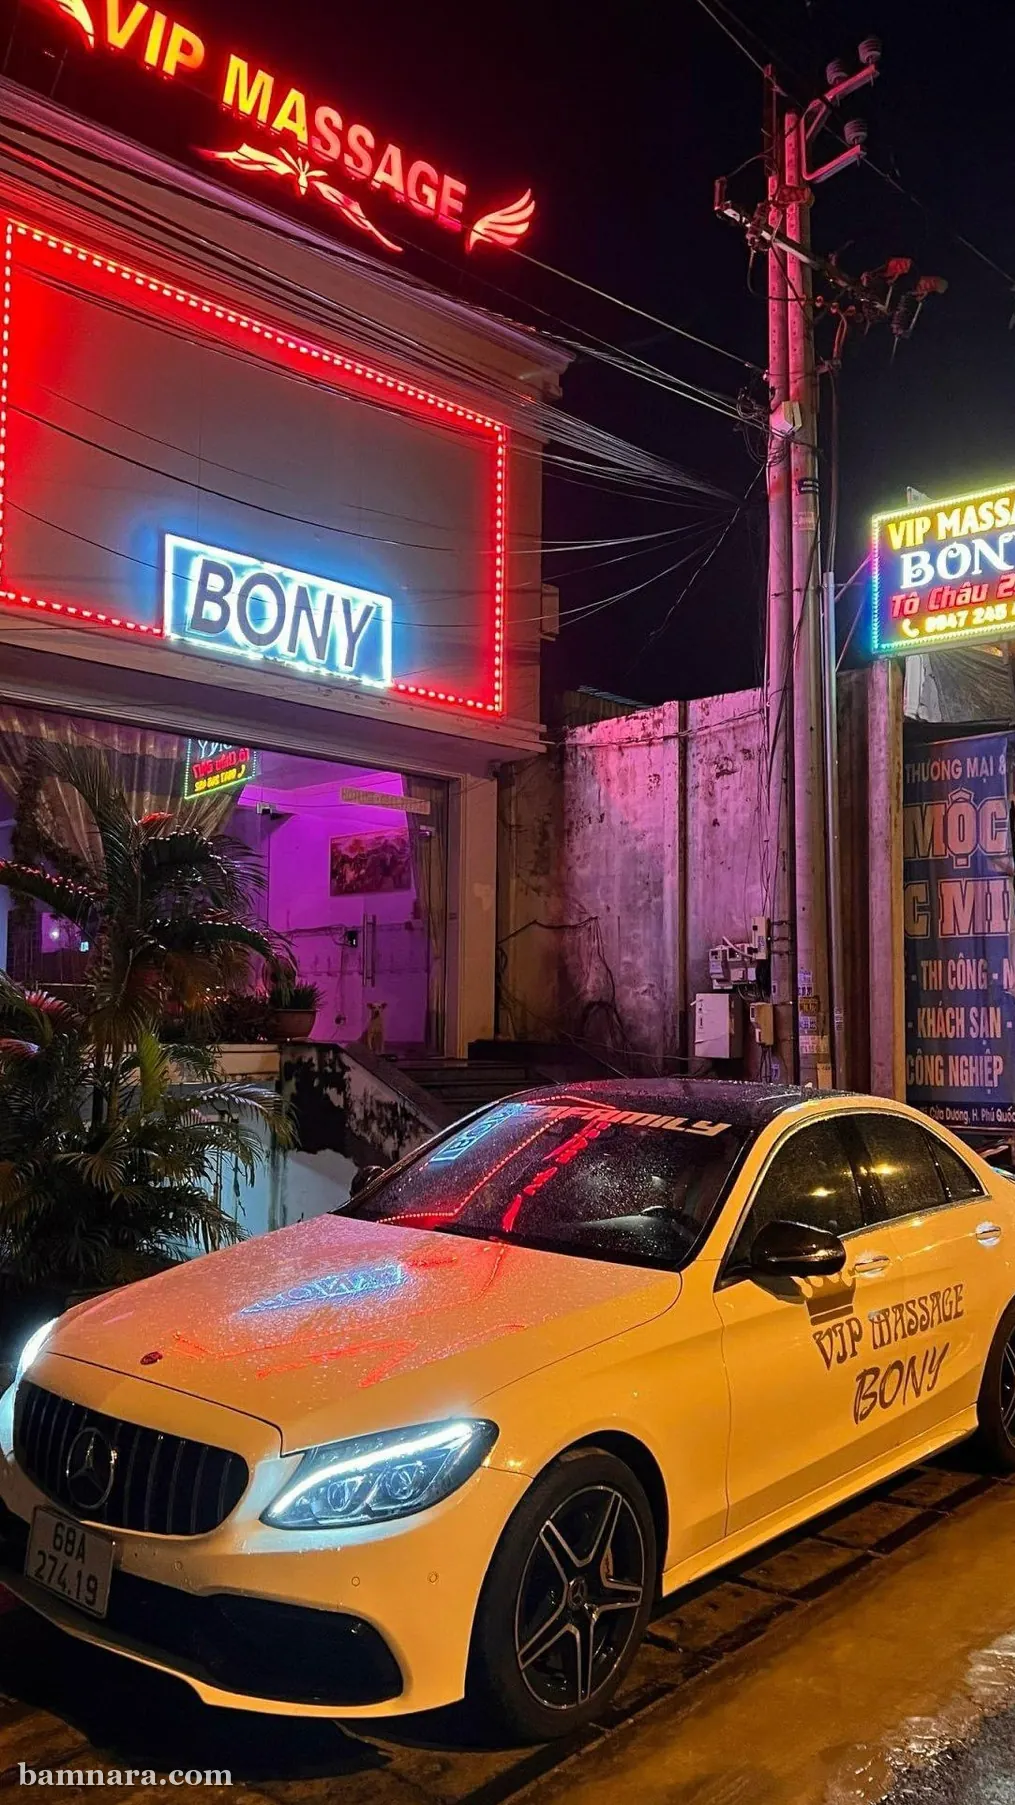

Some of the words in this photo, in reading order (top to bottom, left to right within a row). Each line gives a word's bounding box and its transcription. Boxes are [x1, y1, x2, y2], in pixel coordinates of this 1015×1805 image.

[104, 0, 205, 77] VIP
[221, 53, 467, 222] MASSAGE
[887, 516, 931, 550] VIP
[937, 498, 1015, 541] MASS
[901, 531, 1015, 589] BON
[191, 558, 375, 668] BONY
[892, 591, 920, 618] Tô
[927, 581, 988, 612] Châu
[997, 573, 1015, 599] 2
[905, 756, 962, 784] THƯƠNG
[966, 756, 994, 783] MẠI
[903, 787, 1008, 868] MỘC
[921, 959, 943, 991] THI
[947, 952, 988, 991] CÔNG
[917, 1000, 965, 1039] KHÁCH
[969, 1006, 1001, 1046] SẠN
[906, 1048, 944, 1087] CÔNG
[948, 1048, 1004, 1094] NGHIỆP
[812, 1317, 863, 1371] VIP
[867, 1283, 964, 1350] MASSAGE
[853, 1342, 950, 1425] BONY
[53, 1521, 86, 1564] 68A
[34, 1549, 98, 1606] 274.19
